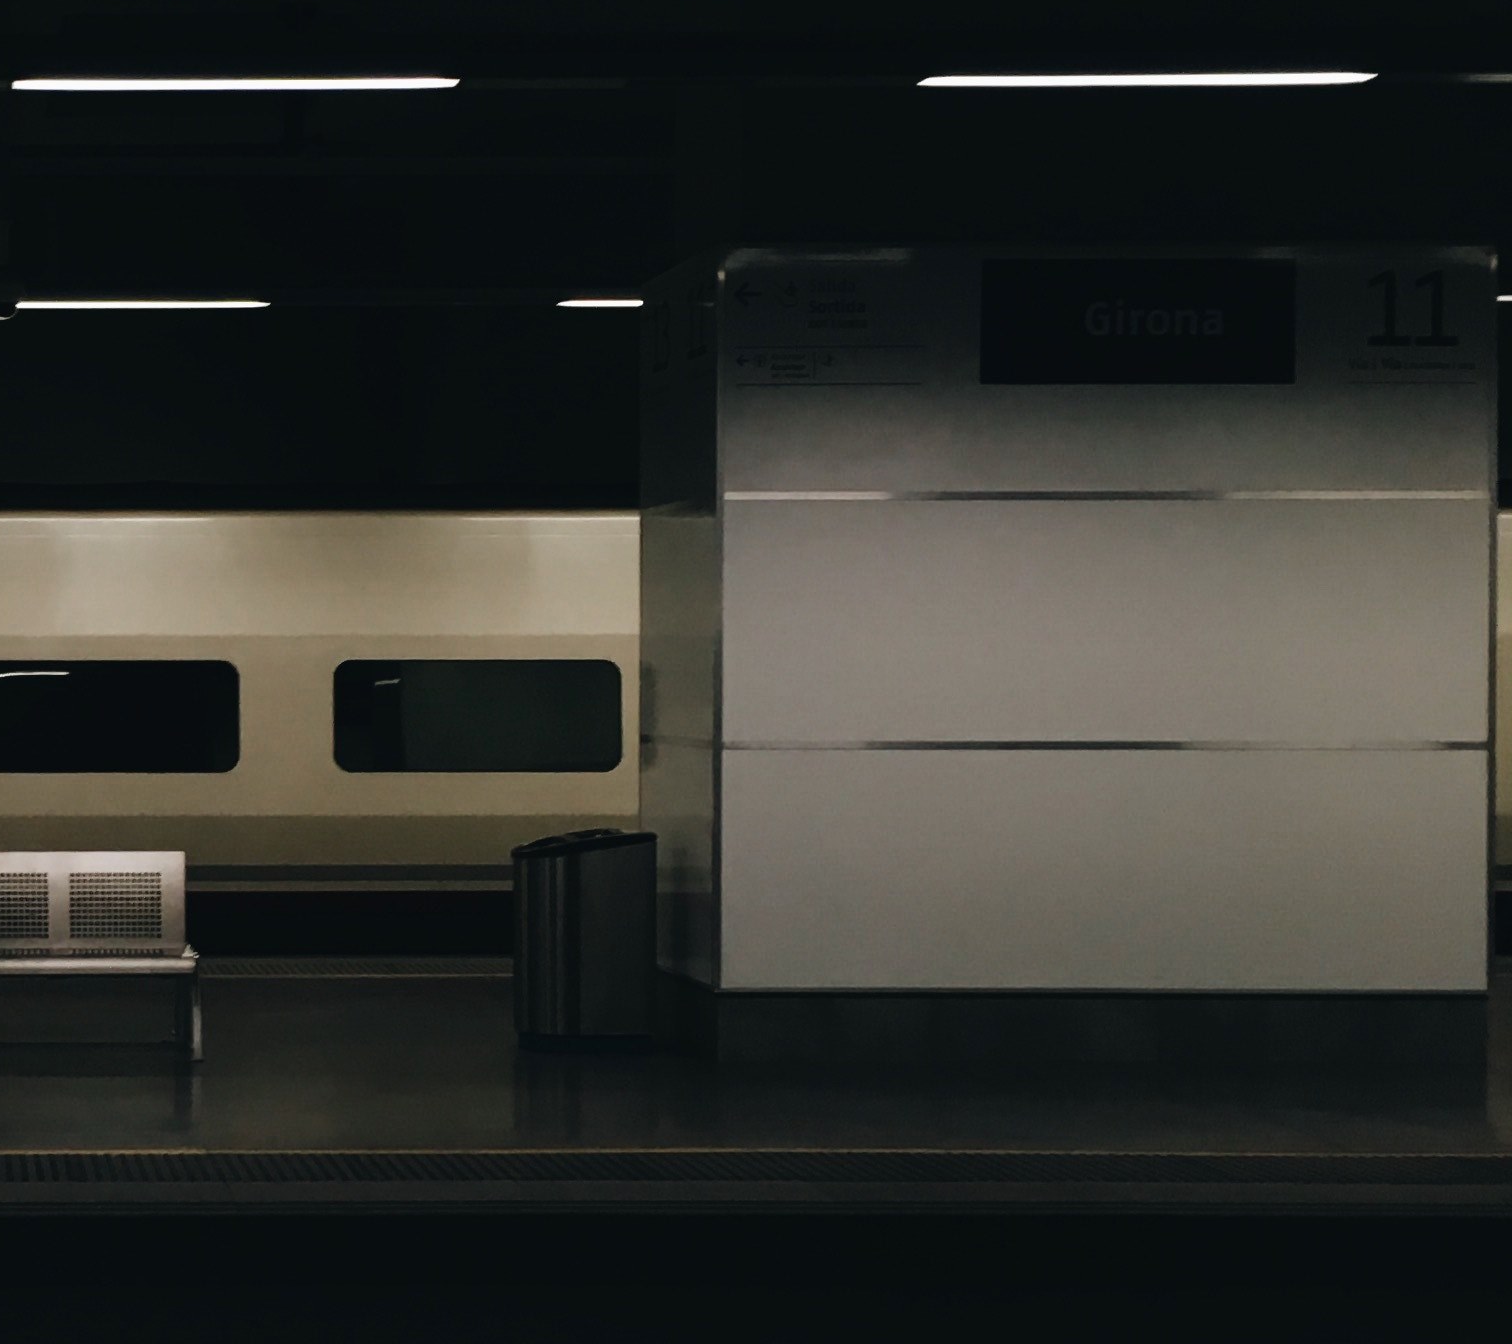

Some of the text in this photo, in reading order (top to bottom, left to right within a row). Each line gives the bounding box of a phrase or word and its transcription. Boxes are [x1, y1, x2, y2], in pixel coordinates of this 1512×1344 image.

[808, 299, 866, 314] Sortida
[1084, 299, 1225, 336] Girona
[1367, 269, 1459, 347] 11
